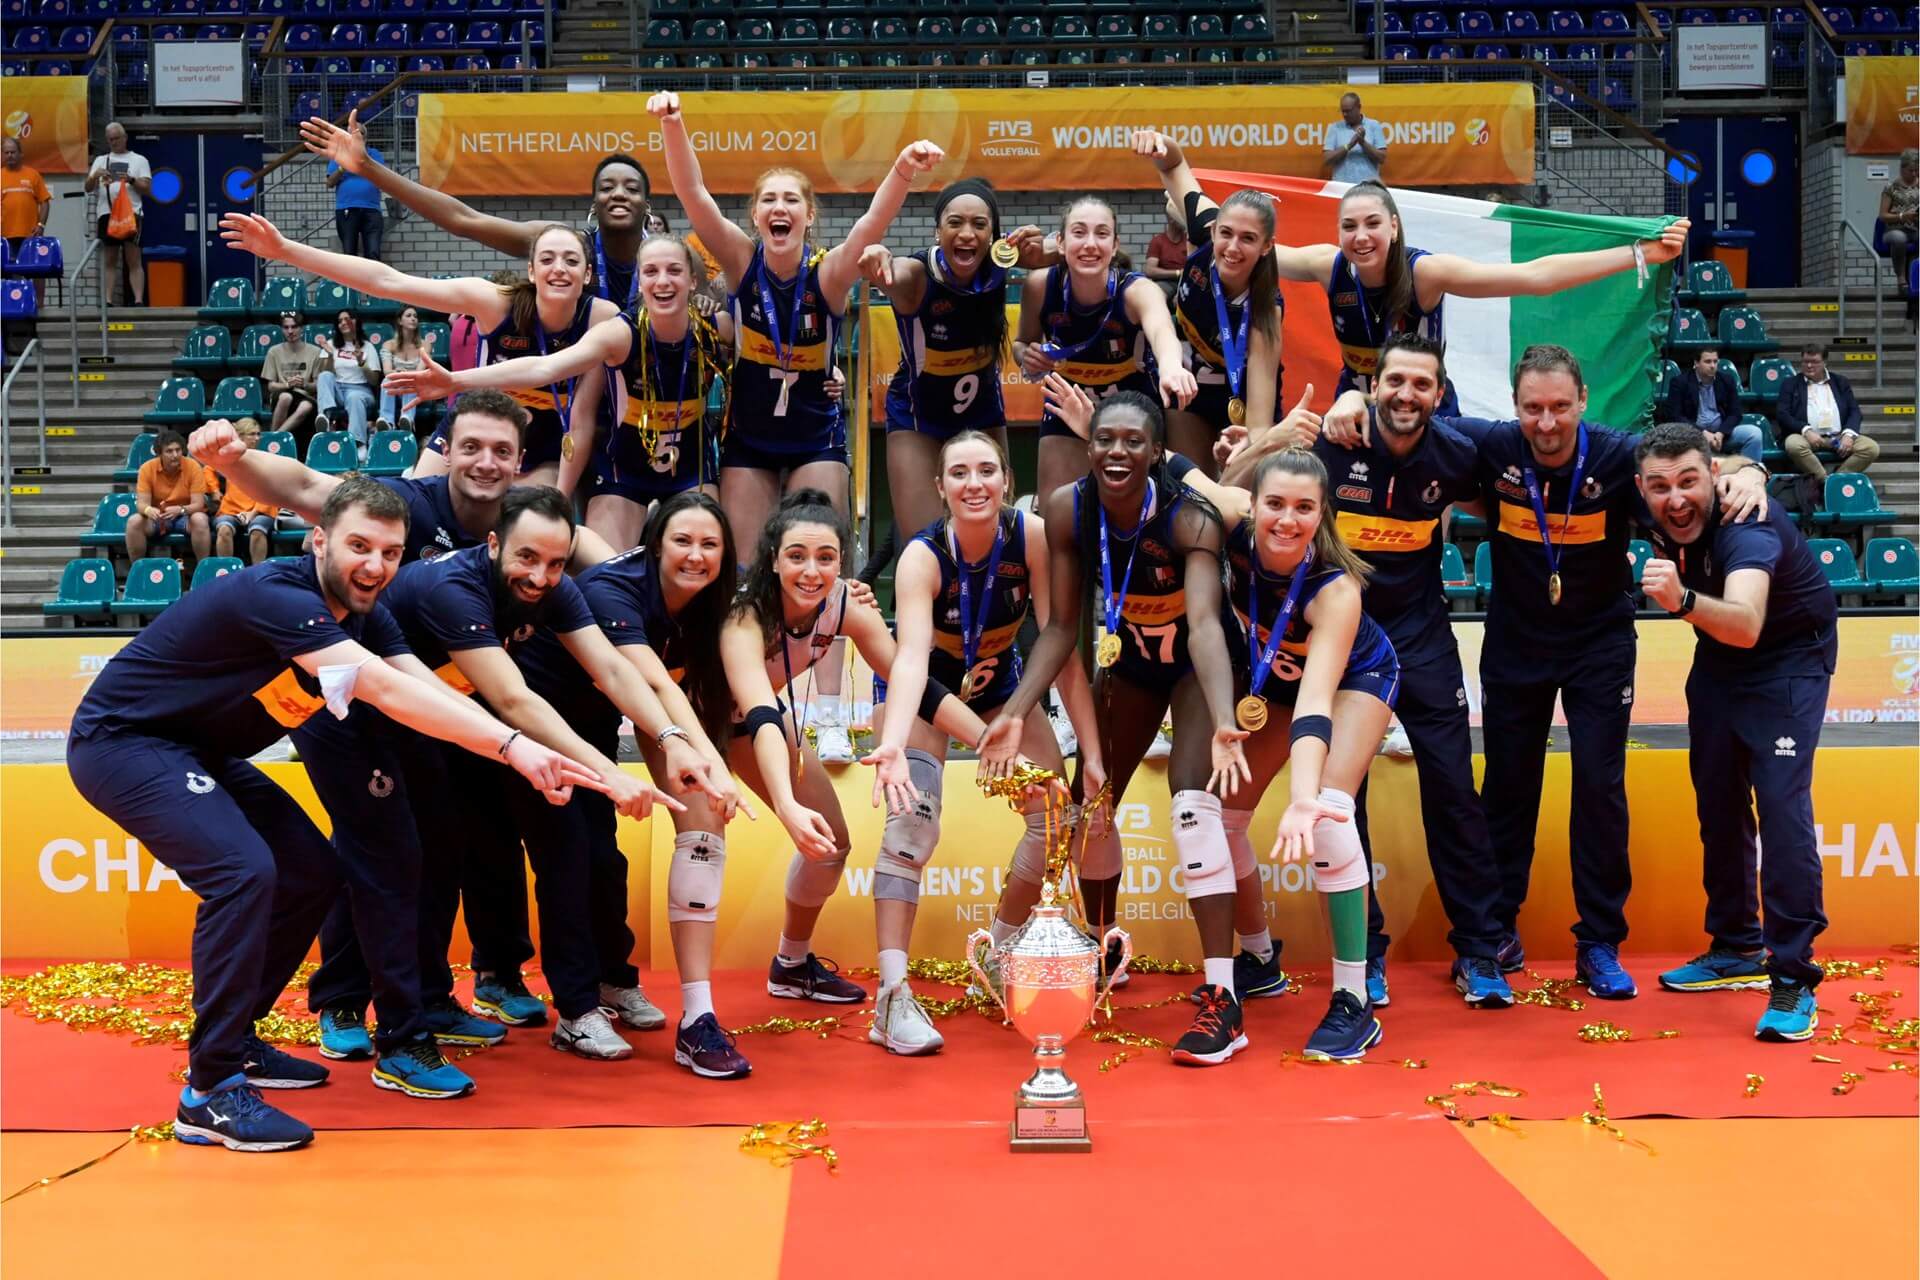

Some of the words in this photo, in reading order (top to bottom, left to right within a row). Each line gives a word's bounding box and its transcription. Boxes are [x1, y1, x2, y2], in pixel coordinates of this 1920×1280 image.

[988, 120, 1032, 137] FIVB
[1207, 123, 1289, 147] WORLD
[1473, 130, 1489, 146] 20
[461, 130, 752, 153] NETHERLANDS-BGIUM
[761, 130, 817, 152] 2021
[981, 147, 1041, 157] VOLLEYBALL
[769, 367, 799, 417] 7
[952, 373, 980, 415] 9
[649, 431, 681, 474] 5
[1358, 527, 1417, 545] DHL
[1125, 621, 1179, 664] 17
